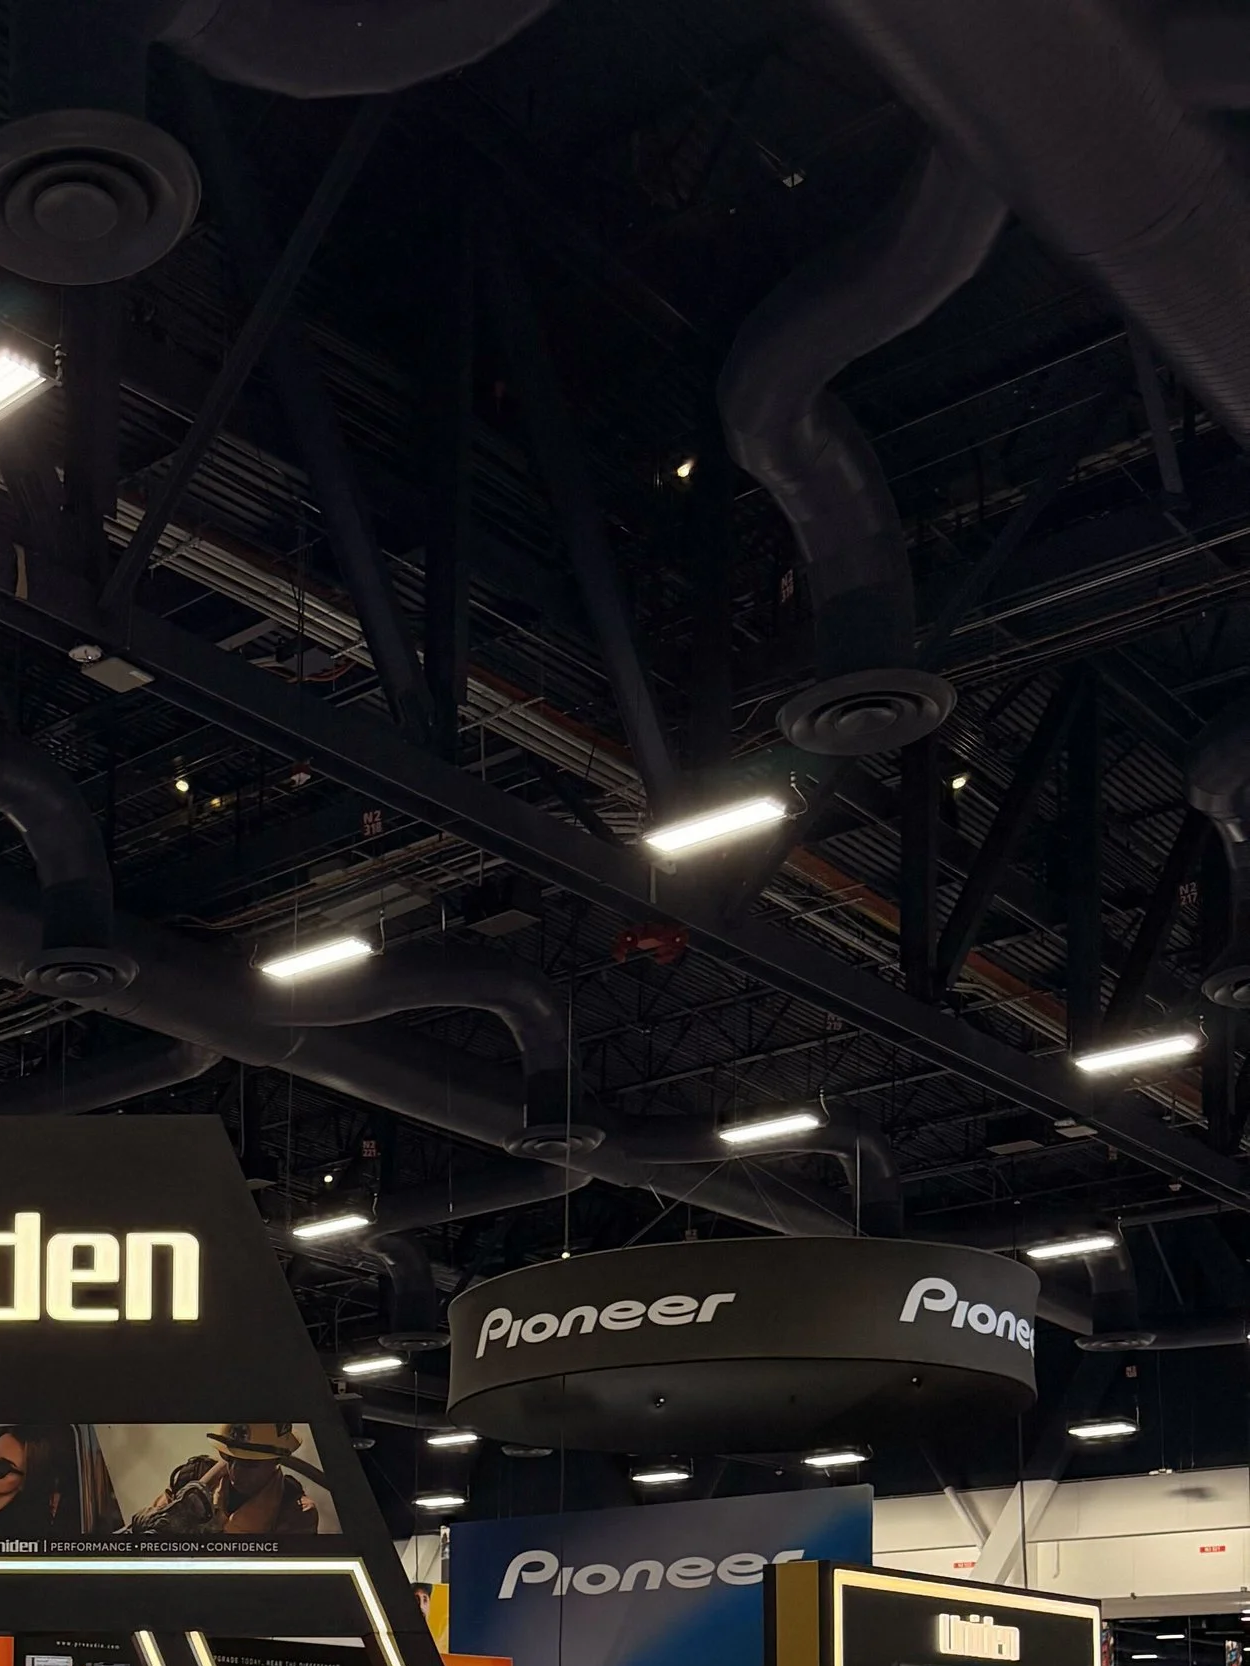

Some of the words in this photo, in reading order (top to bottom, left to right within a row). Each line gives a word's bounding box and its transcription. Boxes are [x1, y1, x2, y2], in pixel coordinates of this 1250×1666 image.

[363, 810, 382, 824] N2
[1180, 882, 1196, 895] N2
[475, 1293, 736, 1359] Pioneer
[50, 1542, 133, 1552] PERFORMANCE
[140, 1542, 199, 1552] PRECISION
[206, 1542, 279, 1552] CONFIDENCE
[938, 1613, 1021, 1662] Uniden
